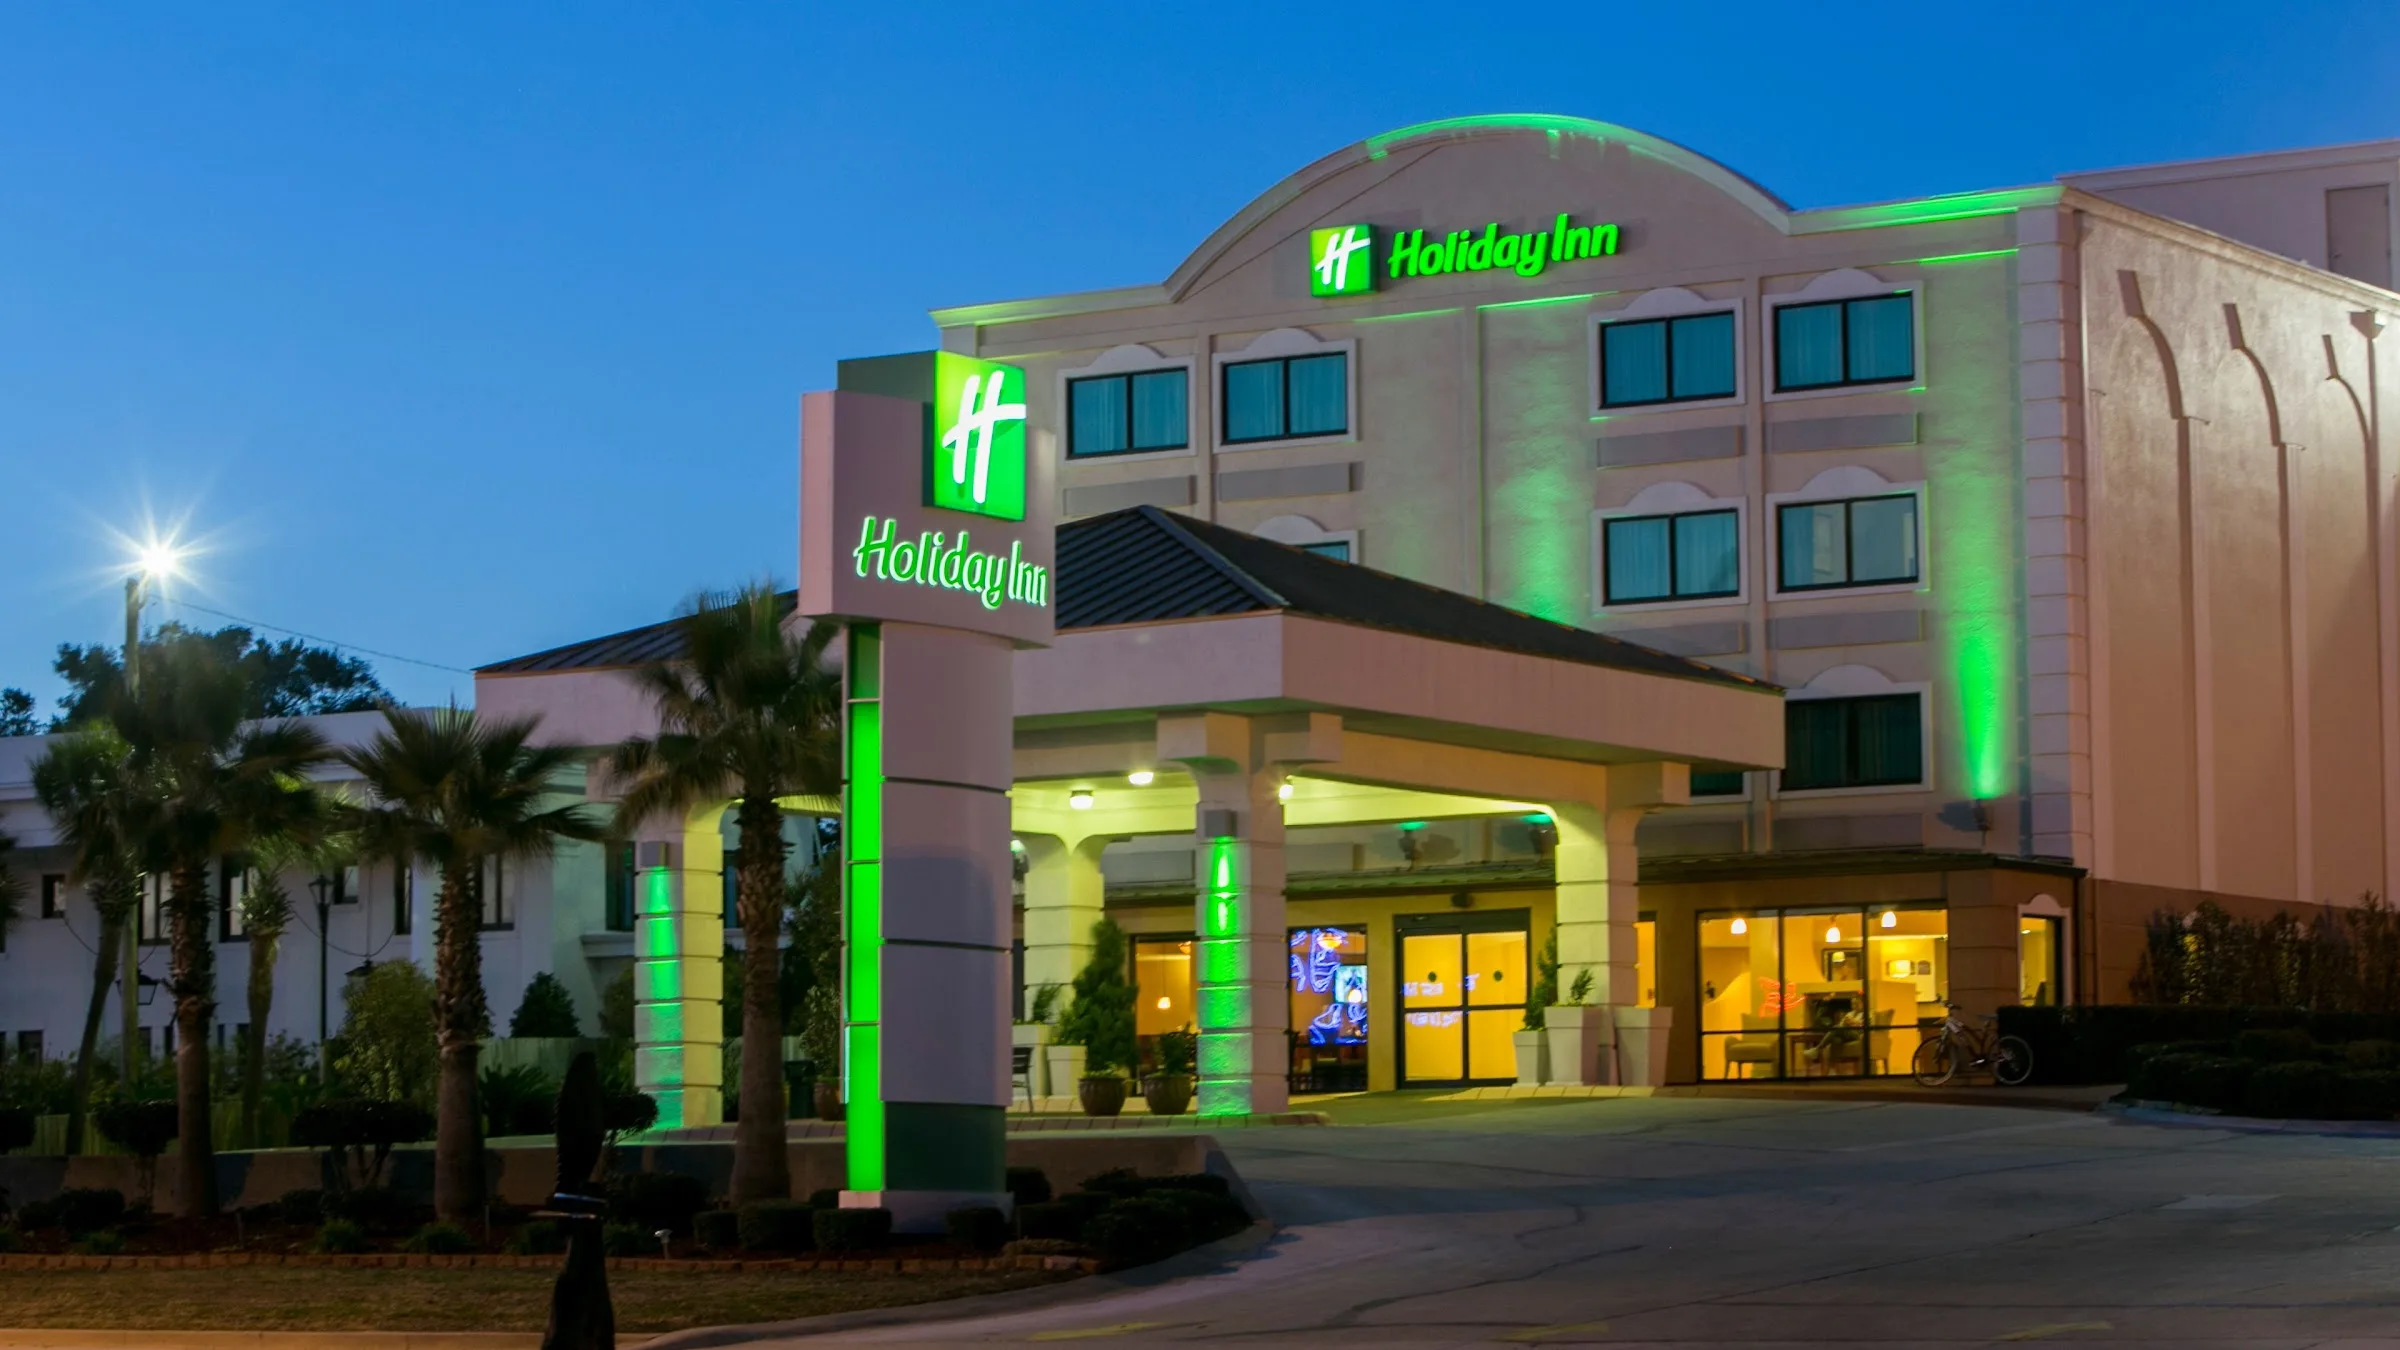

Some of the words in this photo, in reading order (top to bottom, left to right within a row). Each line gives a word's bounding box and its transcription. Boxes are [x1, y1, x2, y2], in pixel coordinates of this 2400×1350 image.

[1388, 222, 1548, 277] Holiday
[1551, 213, 1619, 262] Inn
[853, 516, 1008, 611] Holiday
[1008, 540, 1047, 607] Inn
